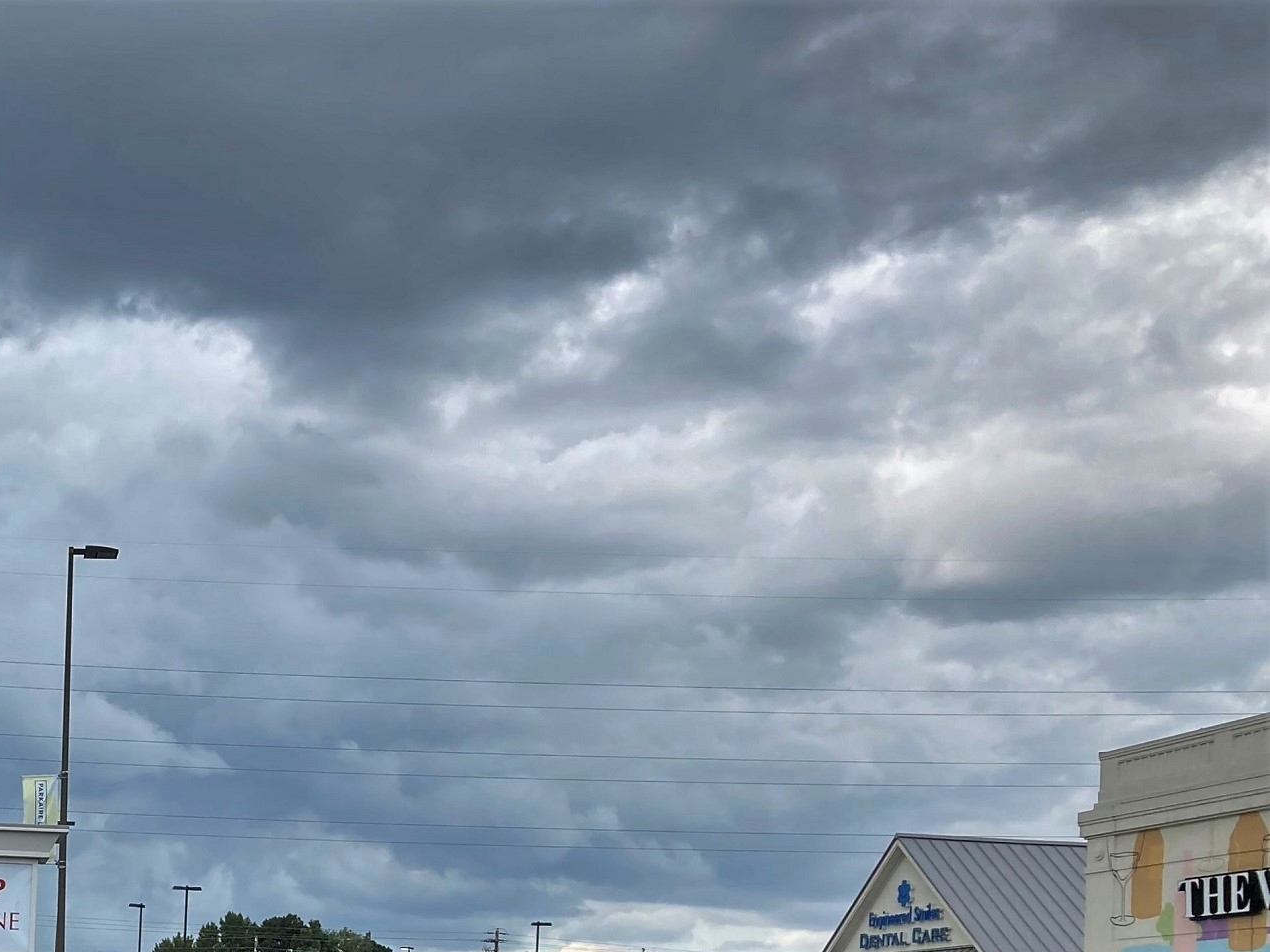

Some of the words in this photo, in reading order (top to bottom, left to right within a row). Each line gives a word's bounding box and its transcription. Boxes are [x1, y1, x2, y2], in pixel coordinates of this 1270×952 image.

[1178, 871, 1251, 918] THE
[860, 932, 910, 950] DENTAL
[912, 927, 952, 945] CARE
